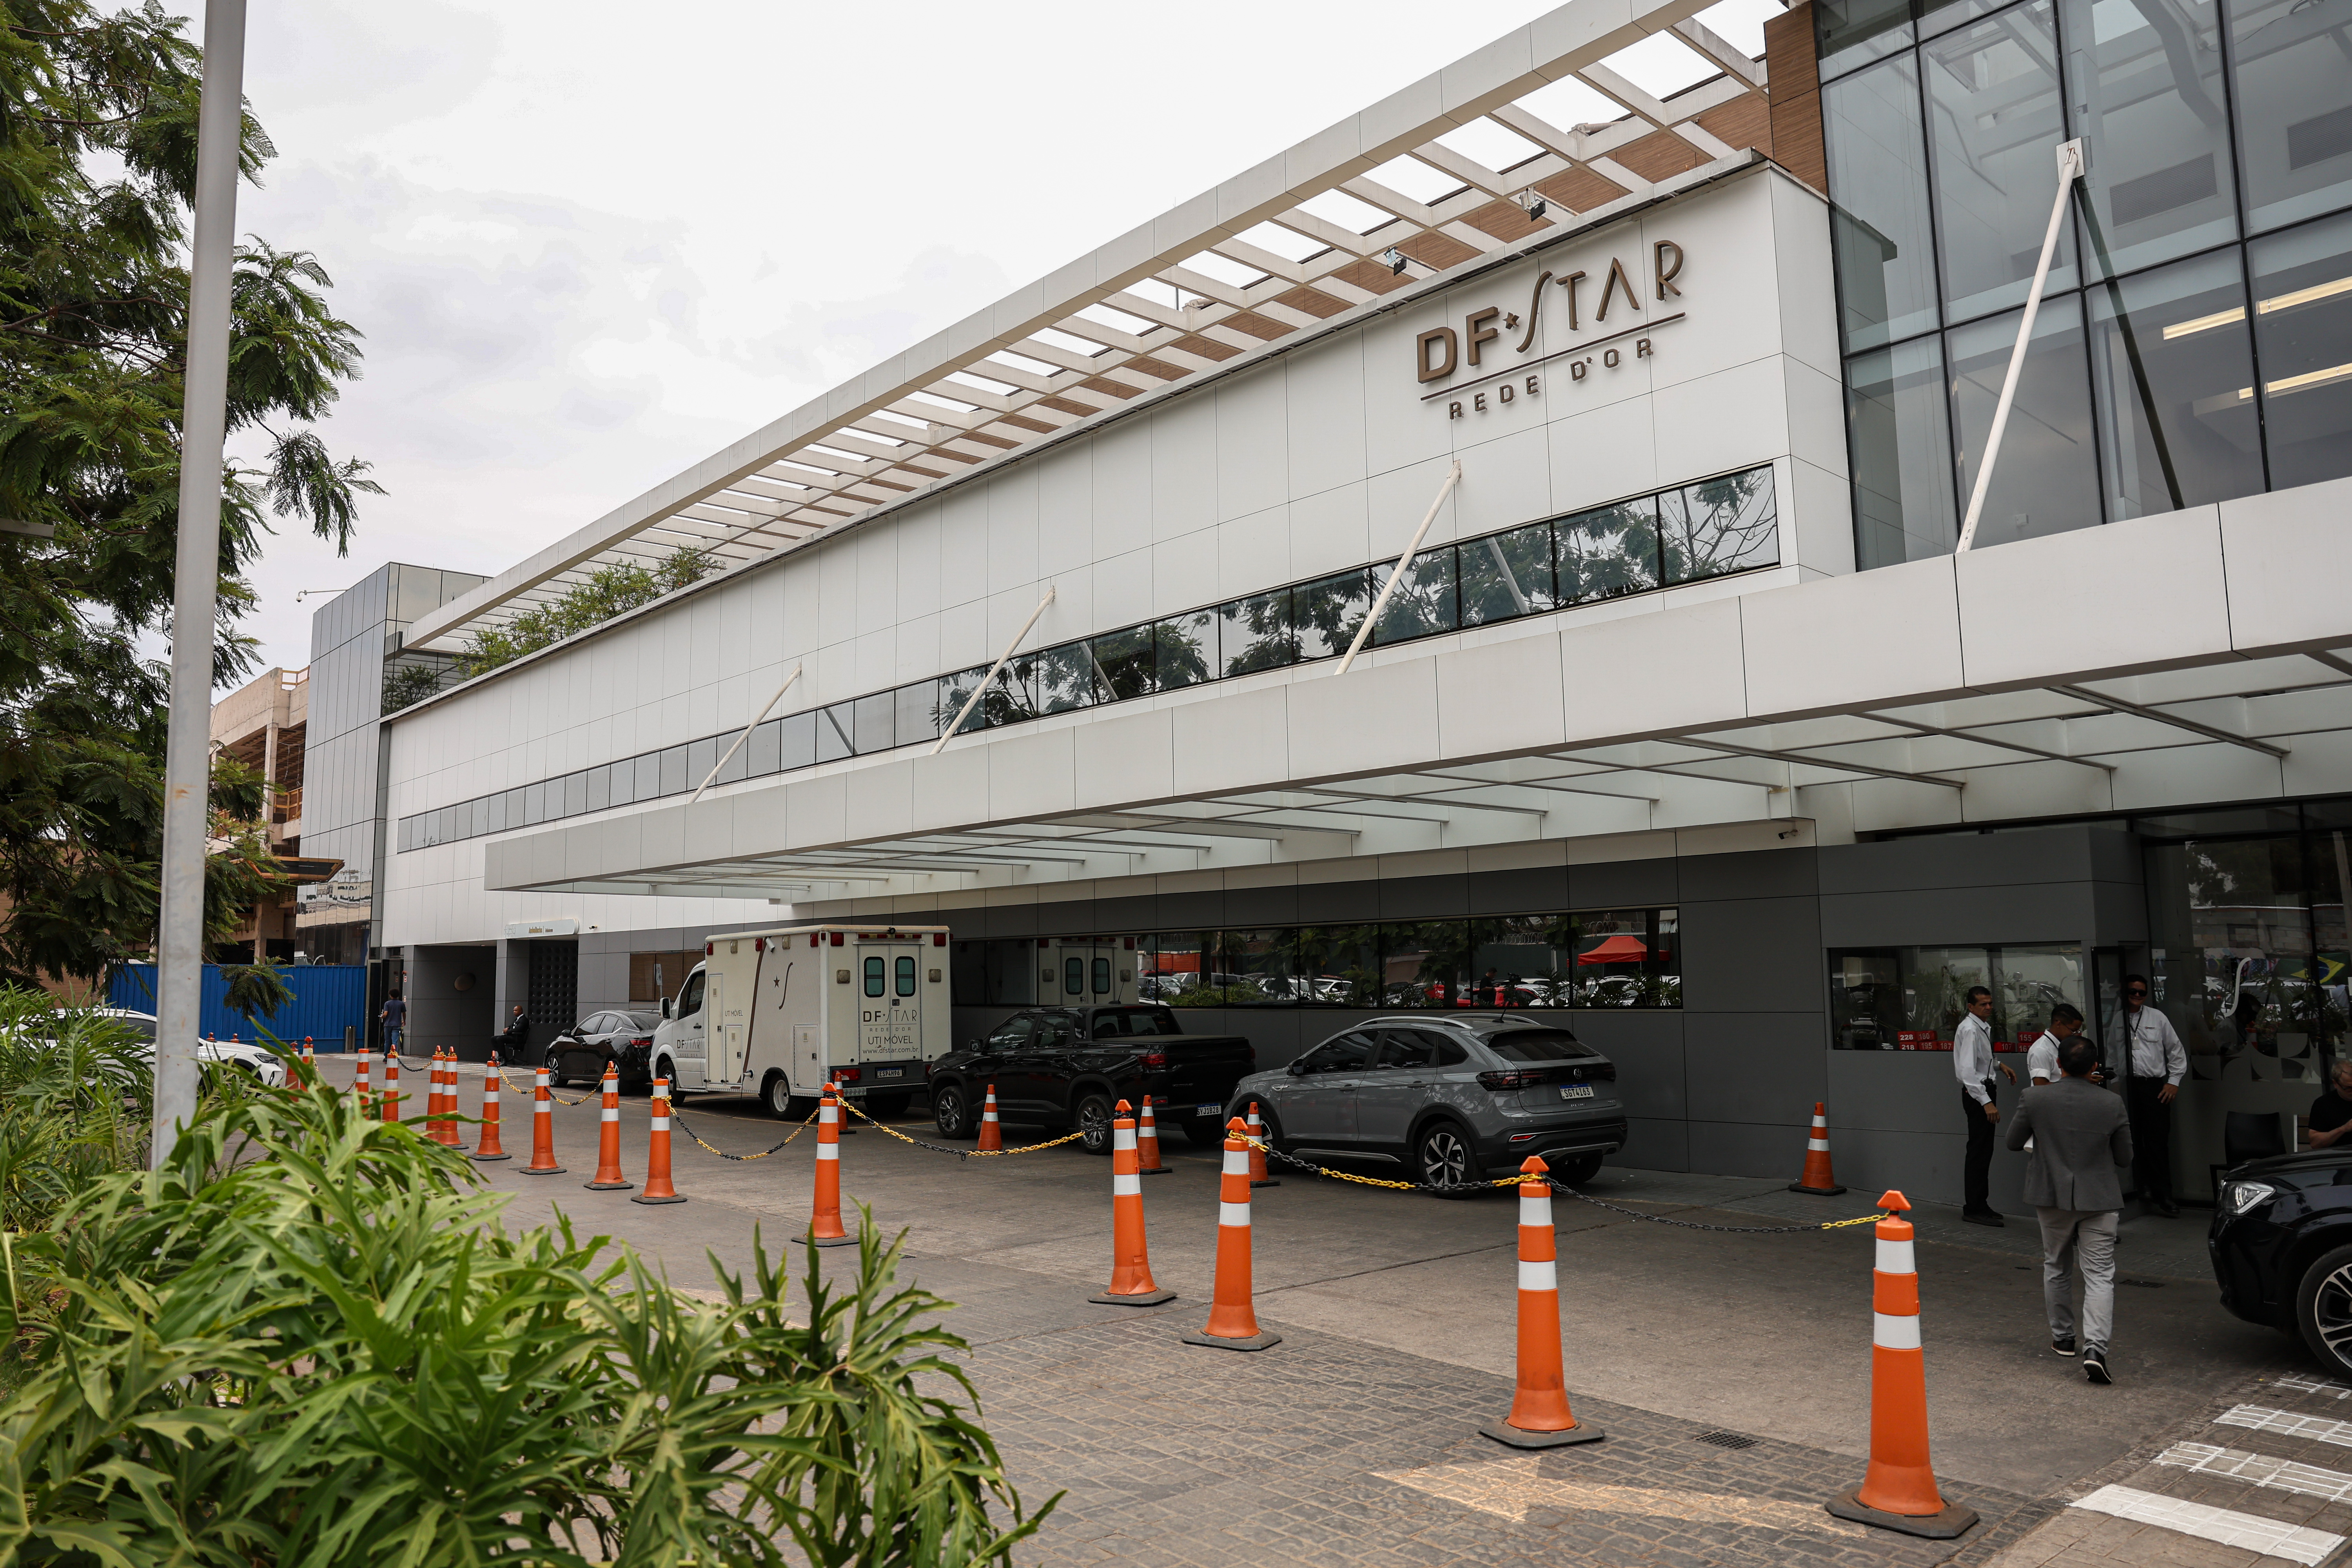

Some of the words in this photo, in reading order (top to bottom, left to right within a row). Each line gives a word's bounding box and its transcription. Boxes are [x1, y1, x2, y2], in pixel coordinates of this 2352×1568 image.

[1448, 374, 1541, 420] REDE
[1570, 338, 1653, 382] D'OR
[868, 1036, 882, 1045] UTI
[884, 1034, 913, 1044] MÓVEL
[1197, 1106, 1219, 1115] SYJ1B28
